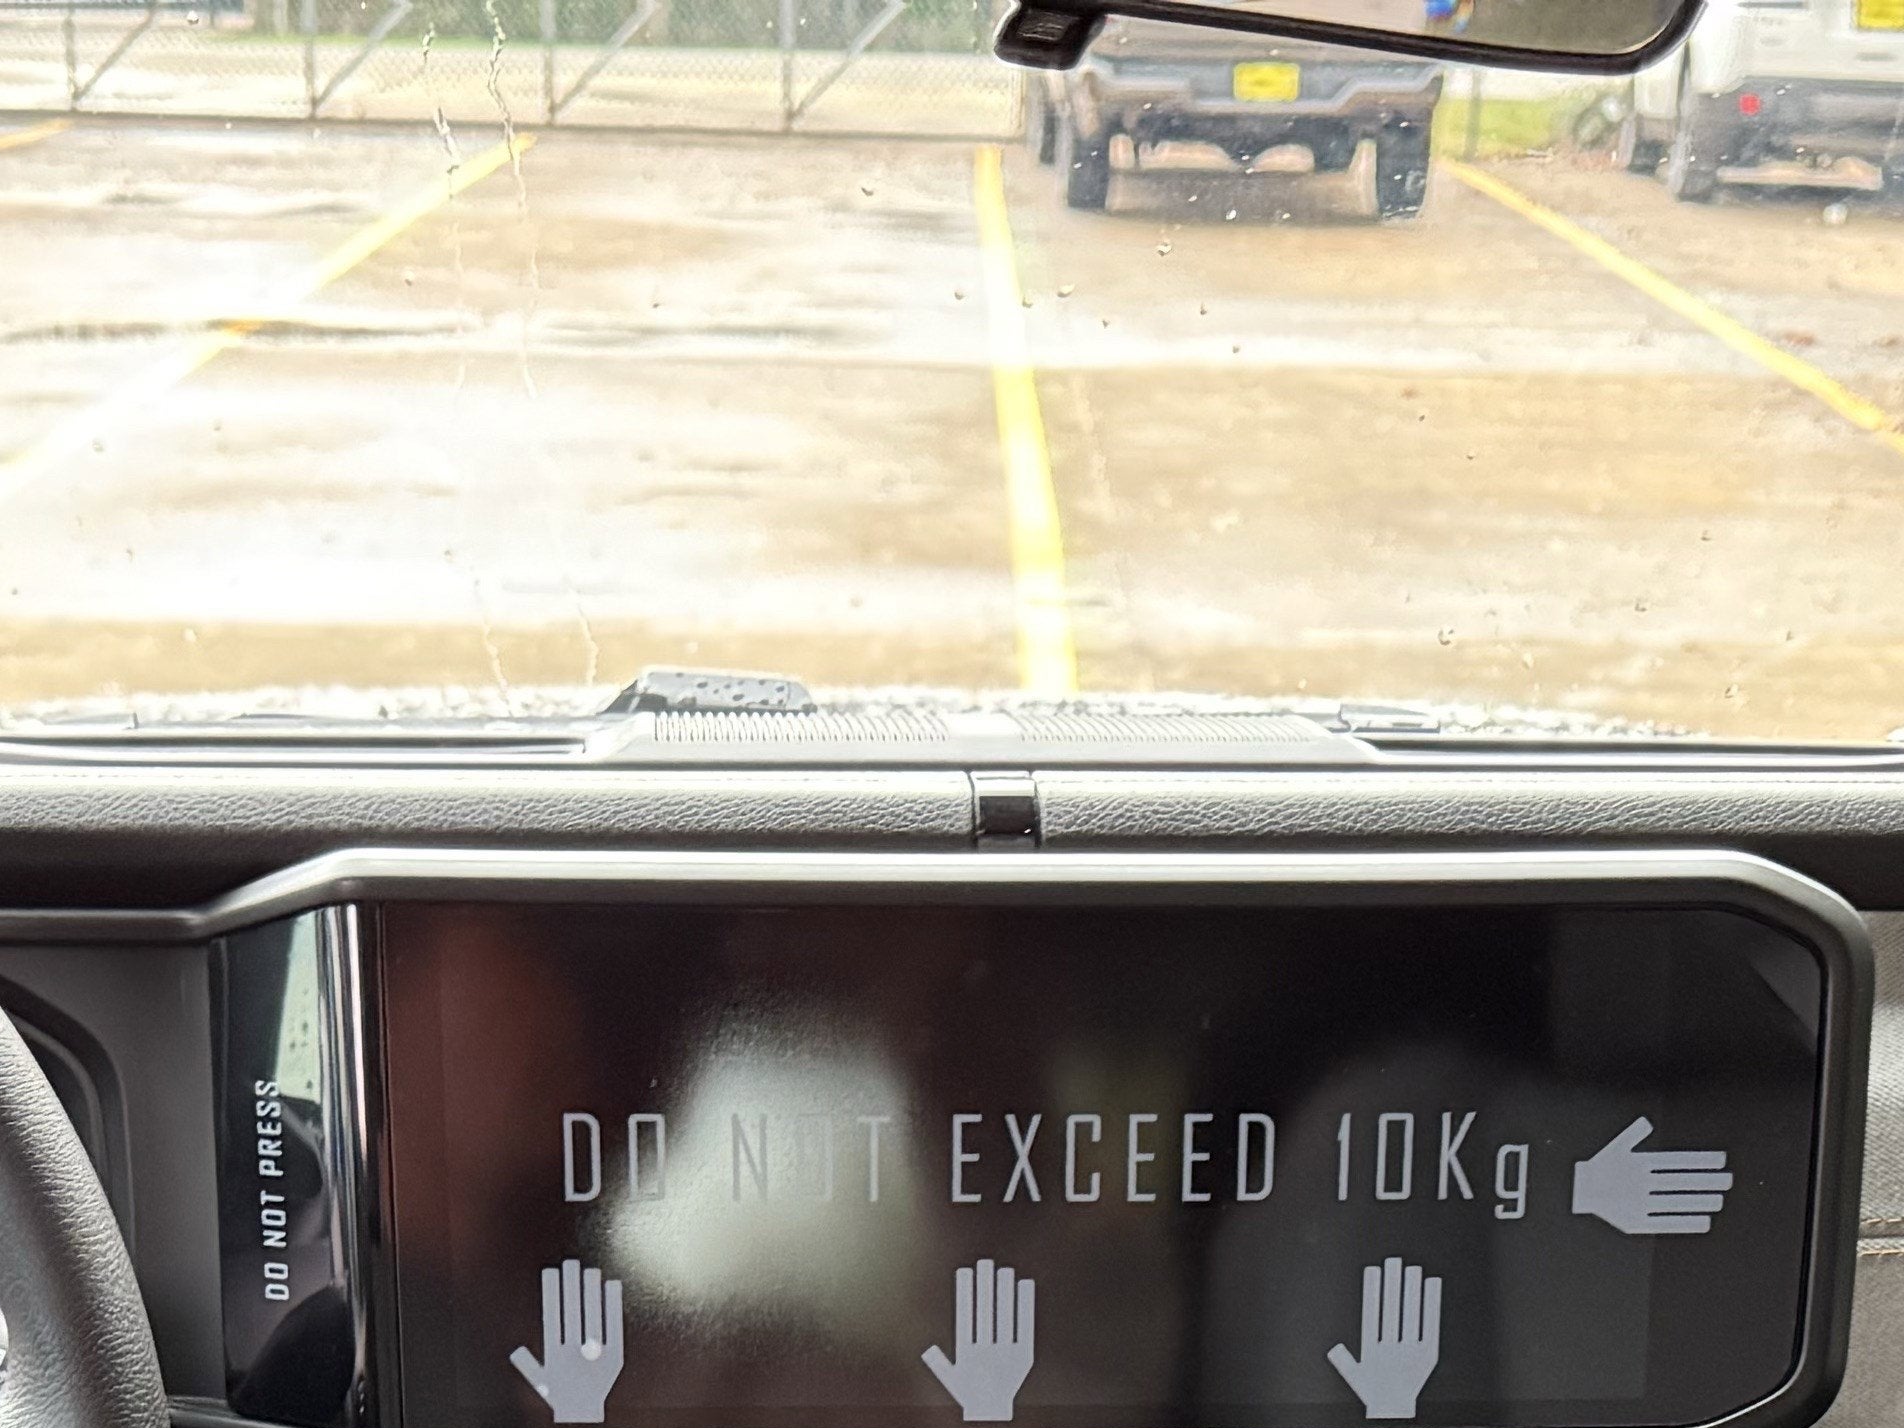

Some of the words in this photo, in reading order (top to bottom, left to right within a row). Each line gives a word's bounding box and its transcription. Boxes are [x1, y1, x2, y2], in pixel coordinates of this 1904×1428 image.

[254, 1079, 285, 1178] PRESS
[562, 1112, 666, 1202] DO
[730, 1112, 892, 1203] NOT
[952, 1112, 1276, 1203] EXCEED
[1336, 1110, 1530, 1220] 10Kg
[260, 1189, 288, 1249] NOT
[263, 1261, 290, 1301] DO
